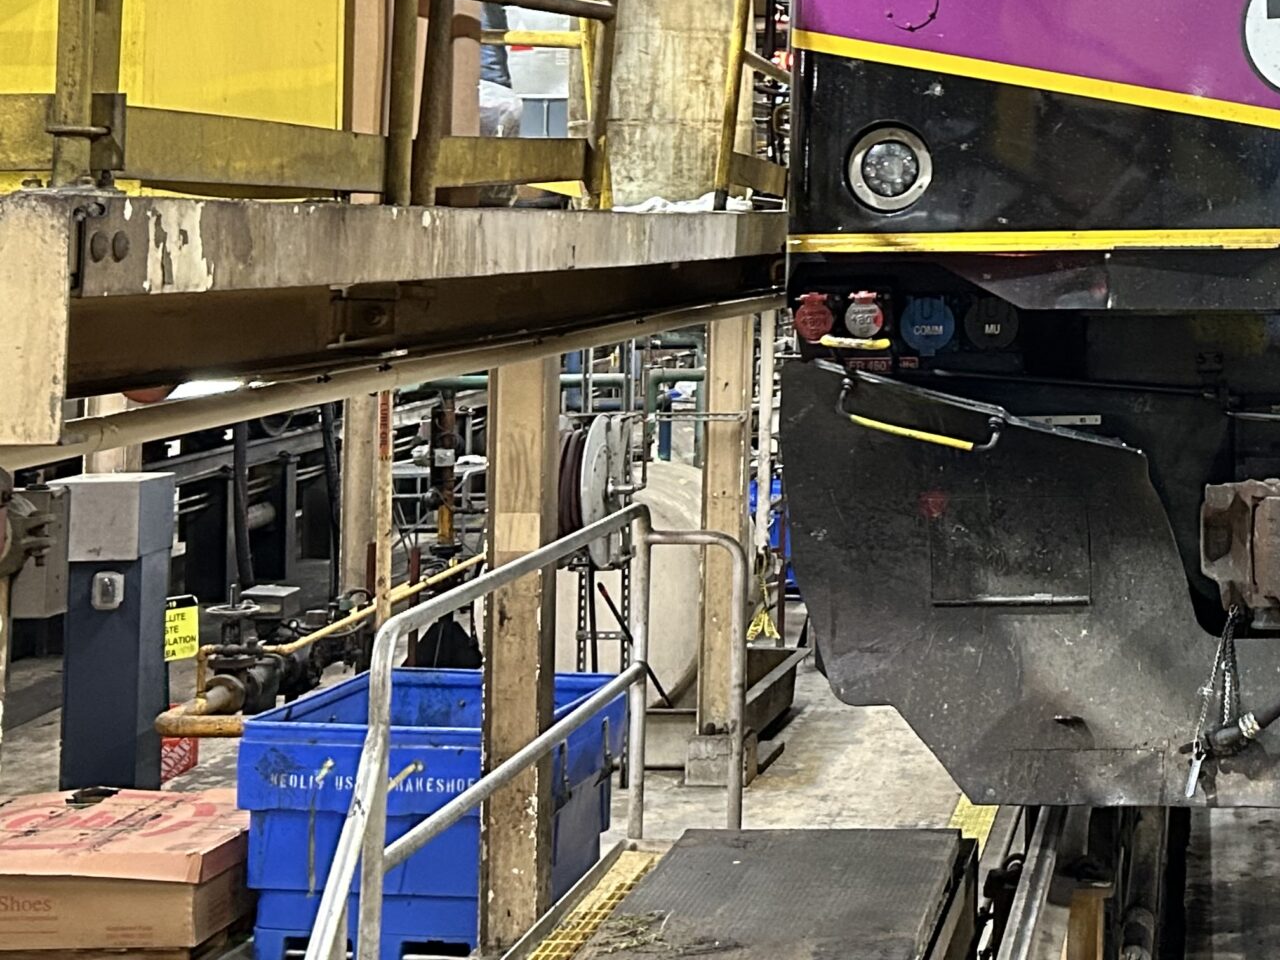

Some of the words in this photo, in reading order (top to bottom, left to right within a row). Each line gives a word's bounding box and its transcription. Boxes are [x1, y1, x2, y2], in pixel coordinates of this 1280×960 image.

[913, 325, 944, 335] COMM
[984, 324, 1001, 335] MU
[0, 895, 52, 912] Shoes
